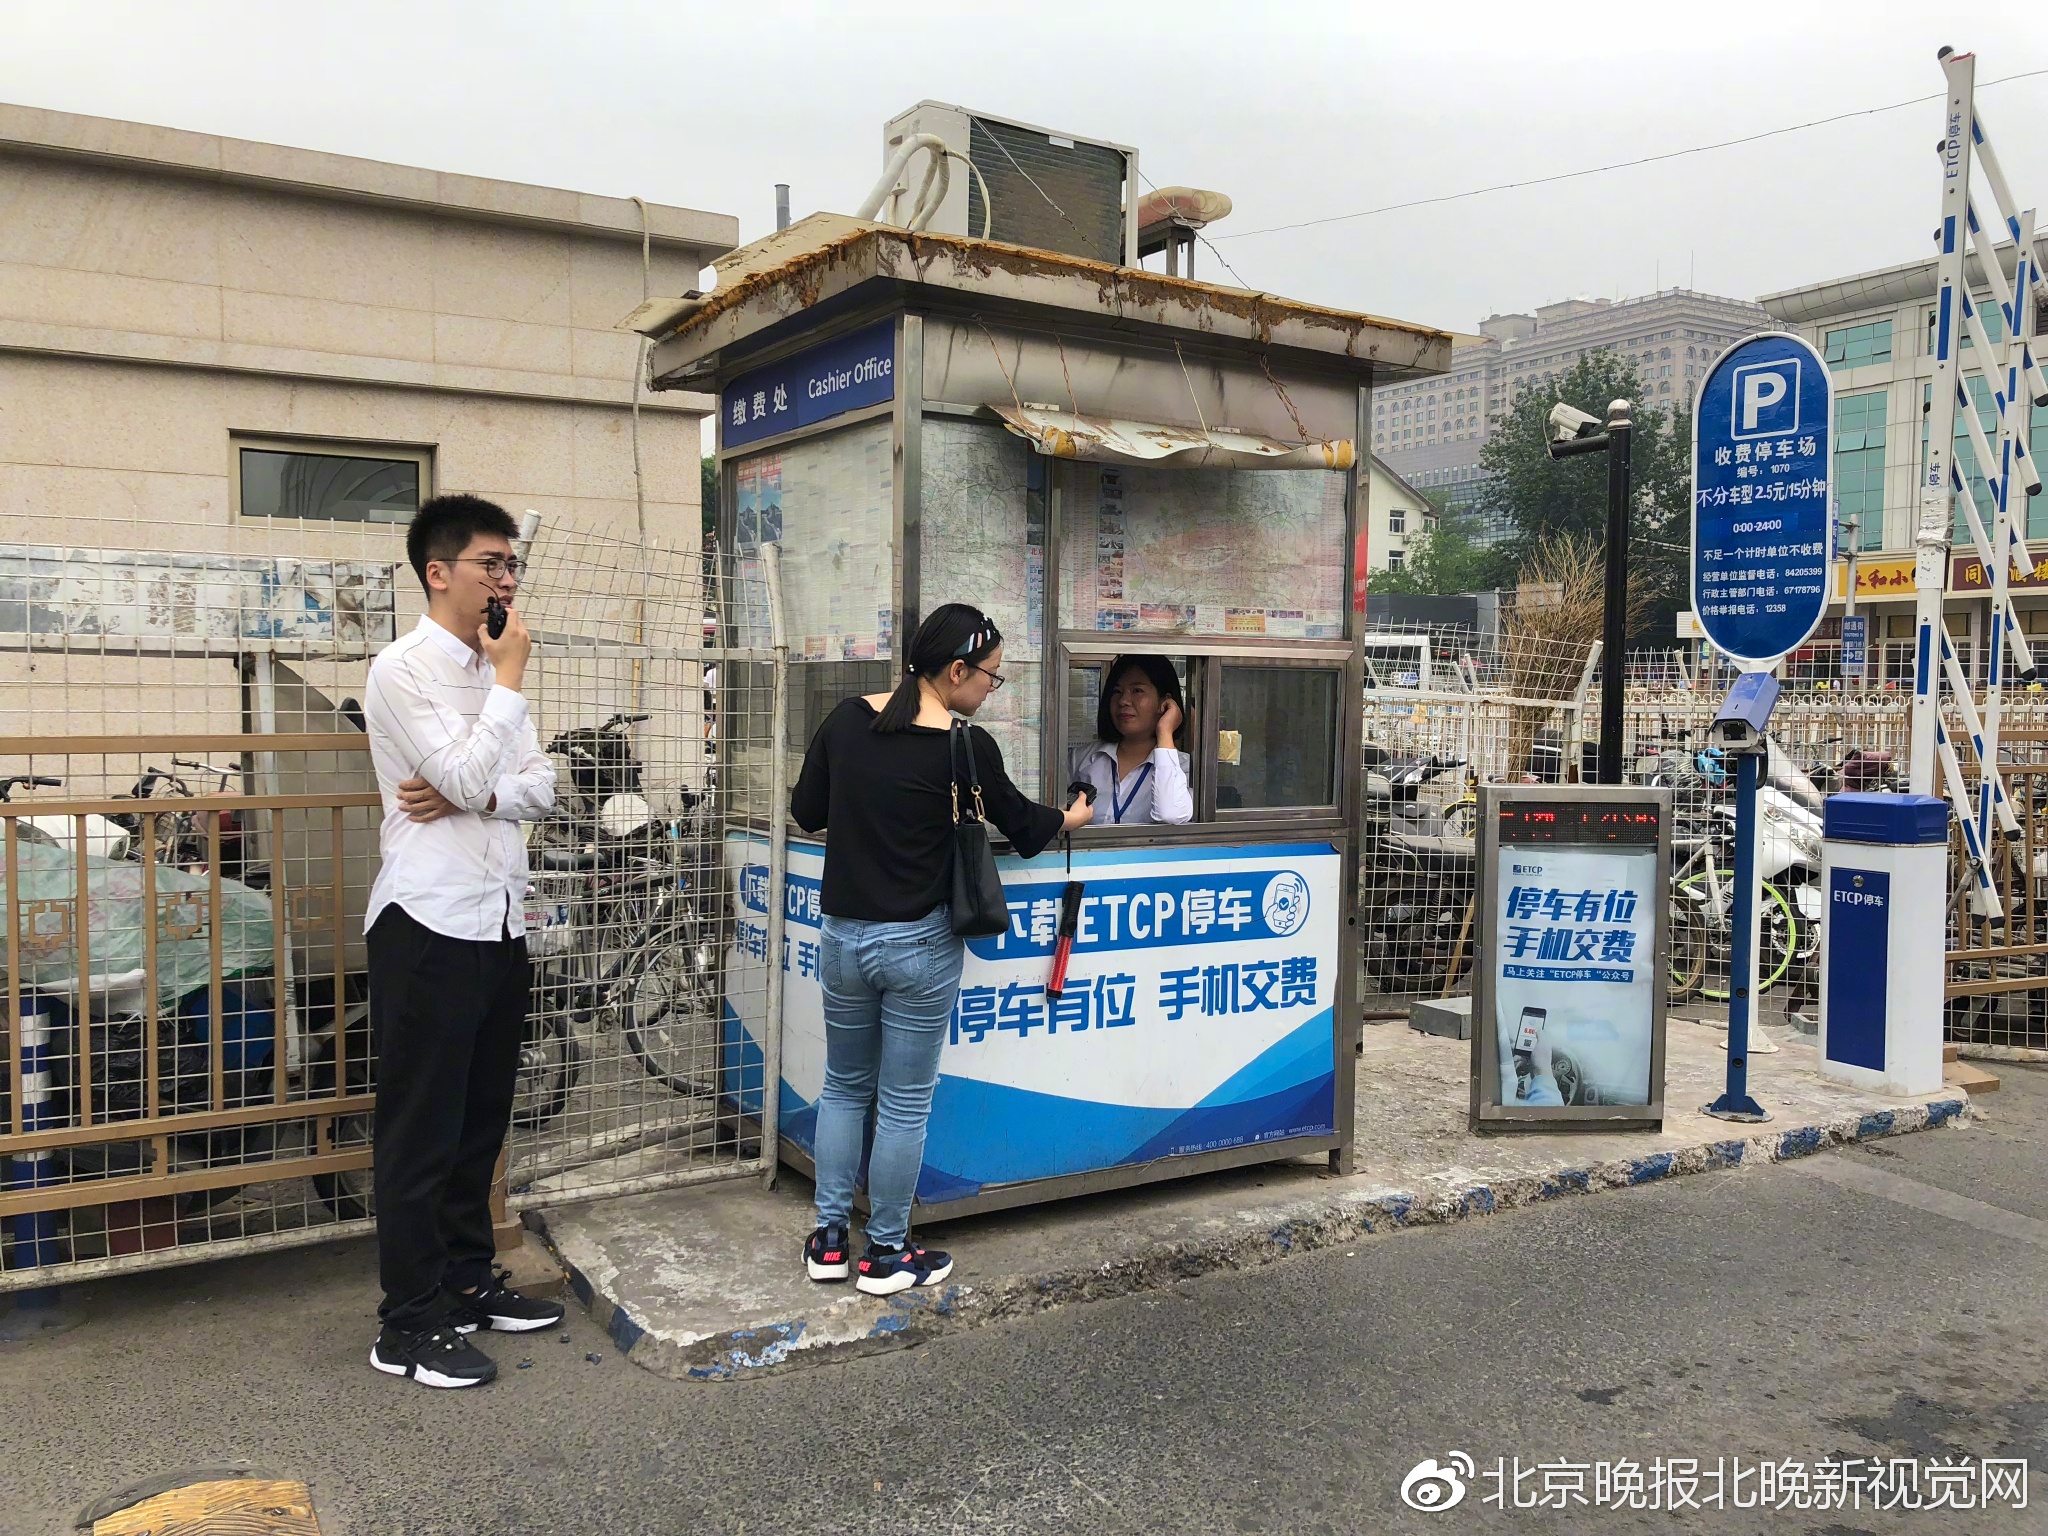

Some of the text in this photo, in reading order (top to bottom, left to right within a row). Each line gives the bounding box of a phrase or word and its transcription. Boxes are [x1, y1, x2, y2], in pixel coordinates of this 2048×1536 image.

[732, 356, 892, 426] 缴费处 Cashier Office
[1742, 371, 1788, 429] P
[1714, 435, 1817, 467] 收费停车场
[1770, 463, 1790, 474] 1070
[1703, 542, 1824, 561] 不足一个计时单位不收费
[1784, 567, 1823, 577] 84205399
[1783, 585, 1821, 595] 67178796
[1764, 603, 1787, 613] 12358
[1522, 865, 1543, 874] ETCP
[1505, 885, 1639, 924] 停车有位
[1834, 890, 1884, 907] ETCP停车
[1503, 925, 1637, 963] 手机交费
[1506, 966, 1546, 979] 马上关注
[950, 956, 1318, 1046] 停车有位 手机交费
[823, 1251, 842, 1262] NIKE
